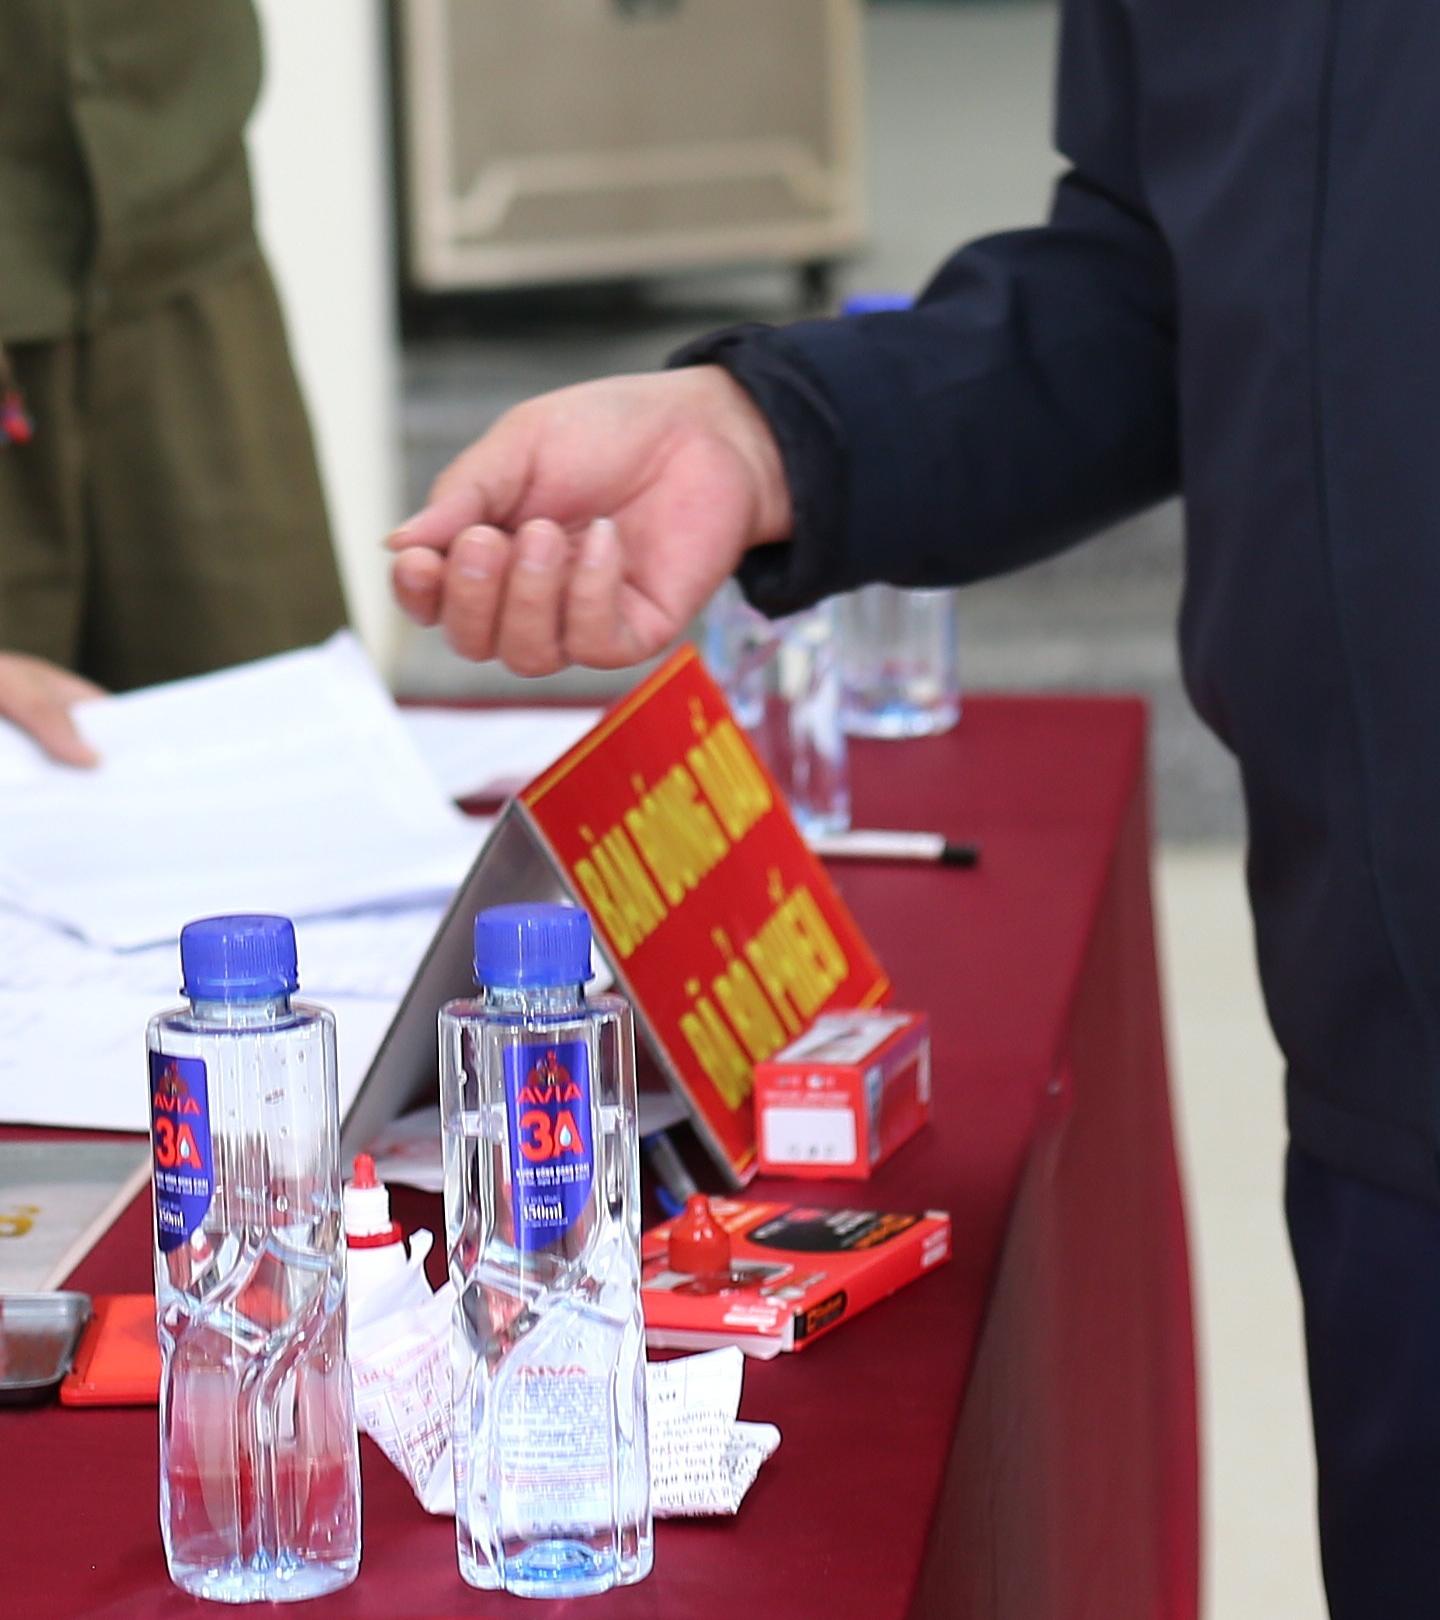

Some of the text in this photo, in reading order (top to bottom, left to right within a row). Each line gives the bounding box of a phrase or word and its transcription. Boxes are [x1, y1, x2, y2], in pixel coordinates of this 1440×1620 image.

[575, 827, 666, 956] BÀN
[745, 868, 847, 1041] PHIẾU
[155, 1092, 201, 1115] AVIA
[517, 1083, 583, 1104] AVIA
[155, 1116, 203, 1170] 3A
[520, 1109, 584, 1161] 3A
